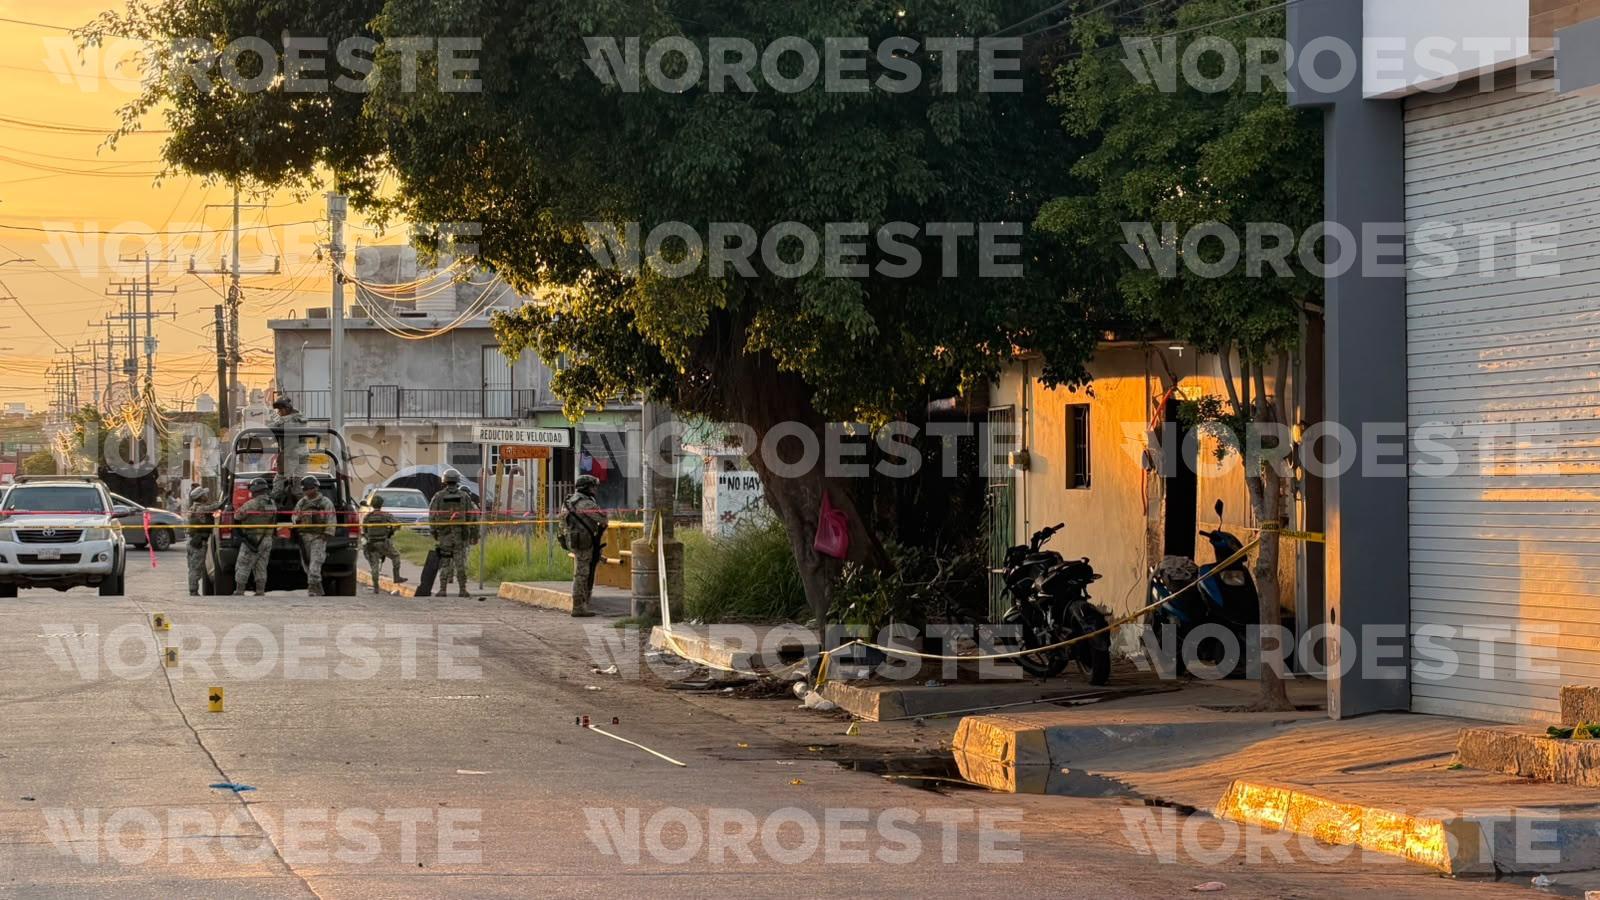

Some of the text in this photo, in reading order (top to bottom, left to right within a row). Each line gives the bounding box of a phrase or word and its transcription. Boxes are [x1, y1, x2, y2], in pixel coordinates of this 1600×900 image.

[479, 429, 562, 443] REDUCTOR DE VELOCIDAD
[743, 476, 761, 491] HAY
